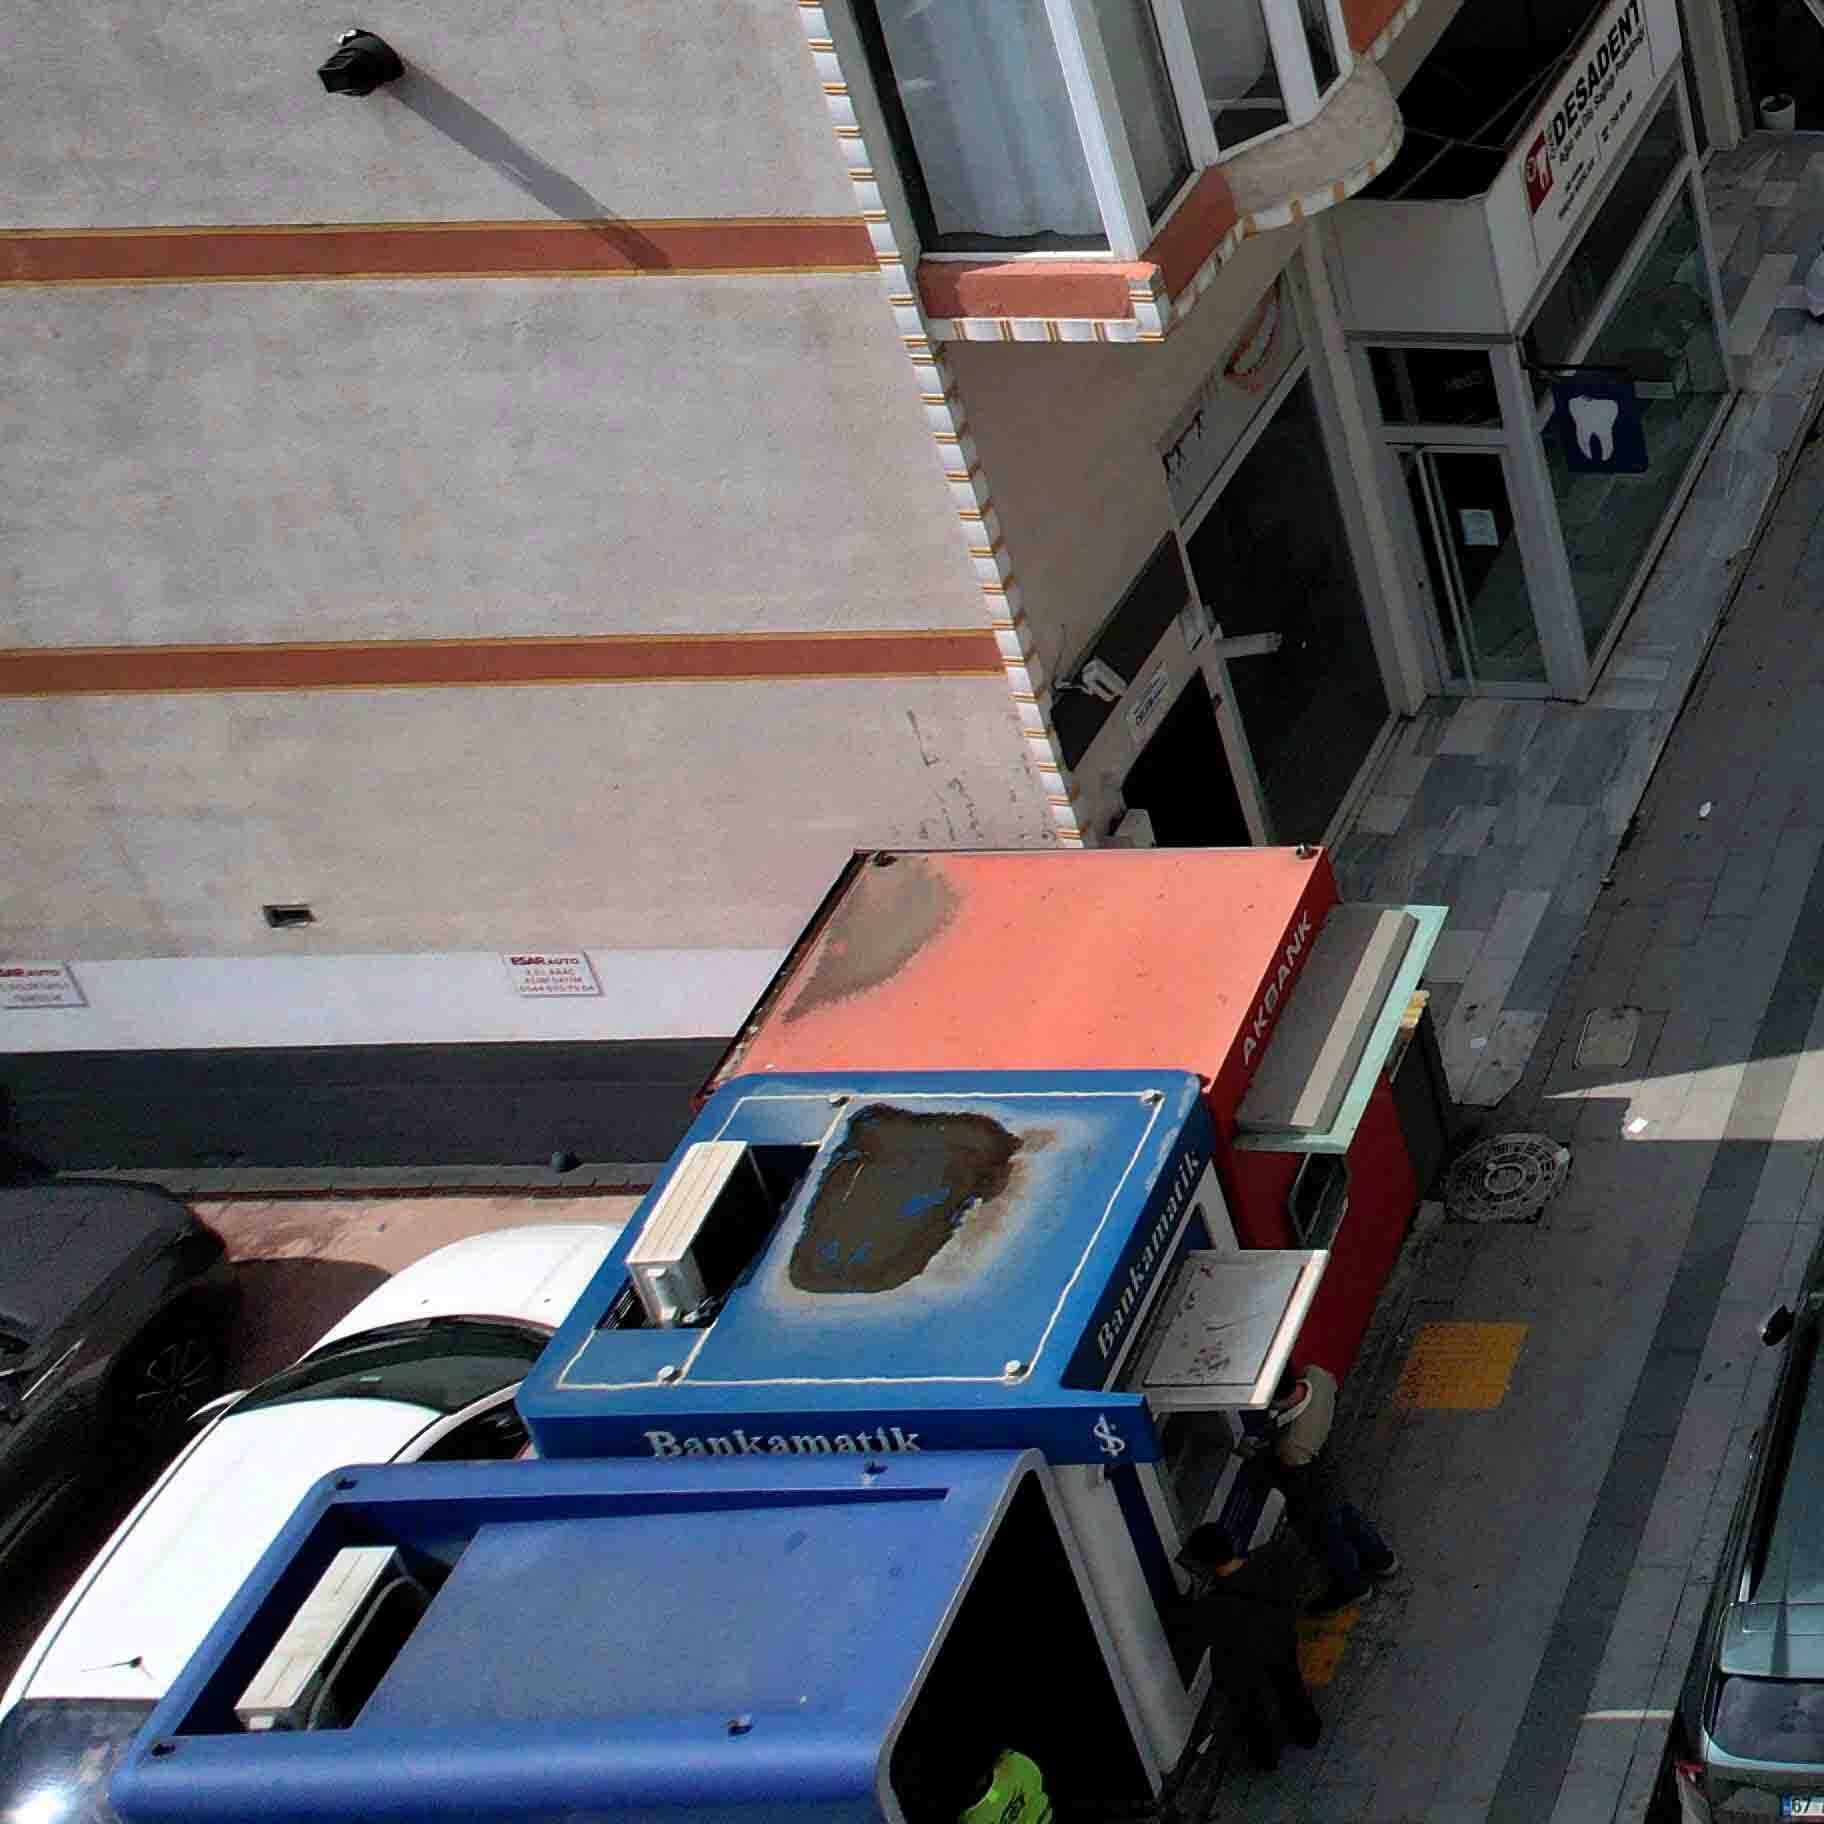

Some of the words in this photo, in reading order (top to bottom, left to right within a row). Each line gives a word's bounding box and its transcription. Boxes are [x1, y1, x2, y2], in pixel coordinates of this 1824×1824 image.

[1242, 911, 1313, 1066] AKBANK
[1096, 1147, 1201, 1359] Bankamatik
[645, 1427, 920, 1457] Bankamatik
[1791, 1797, 1810, 1813] 67
